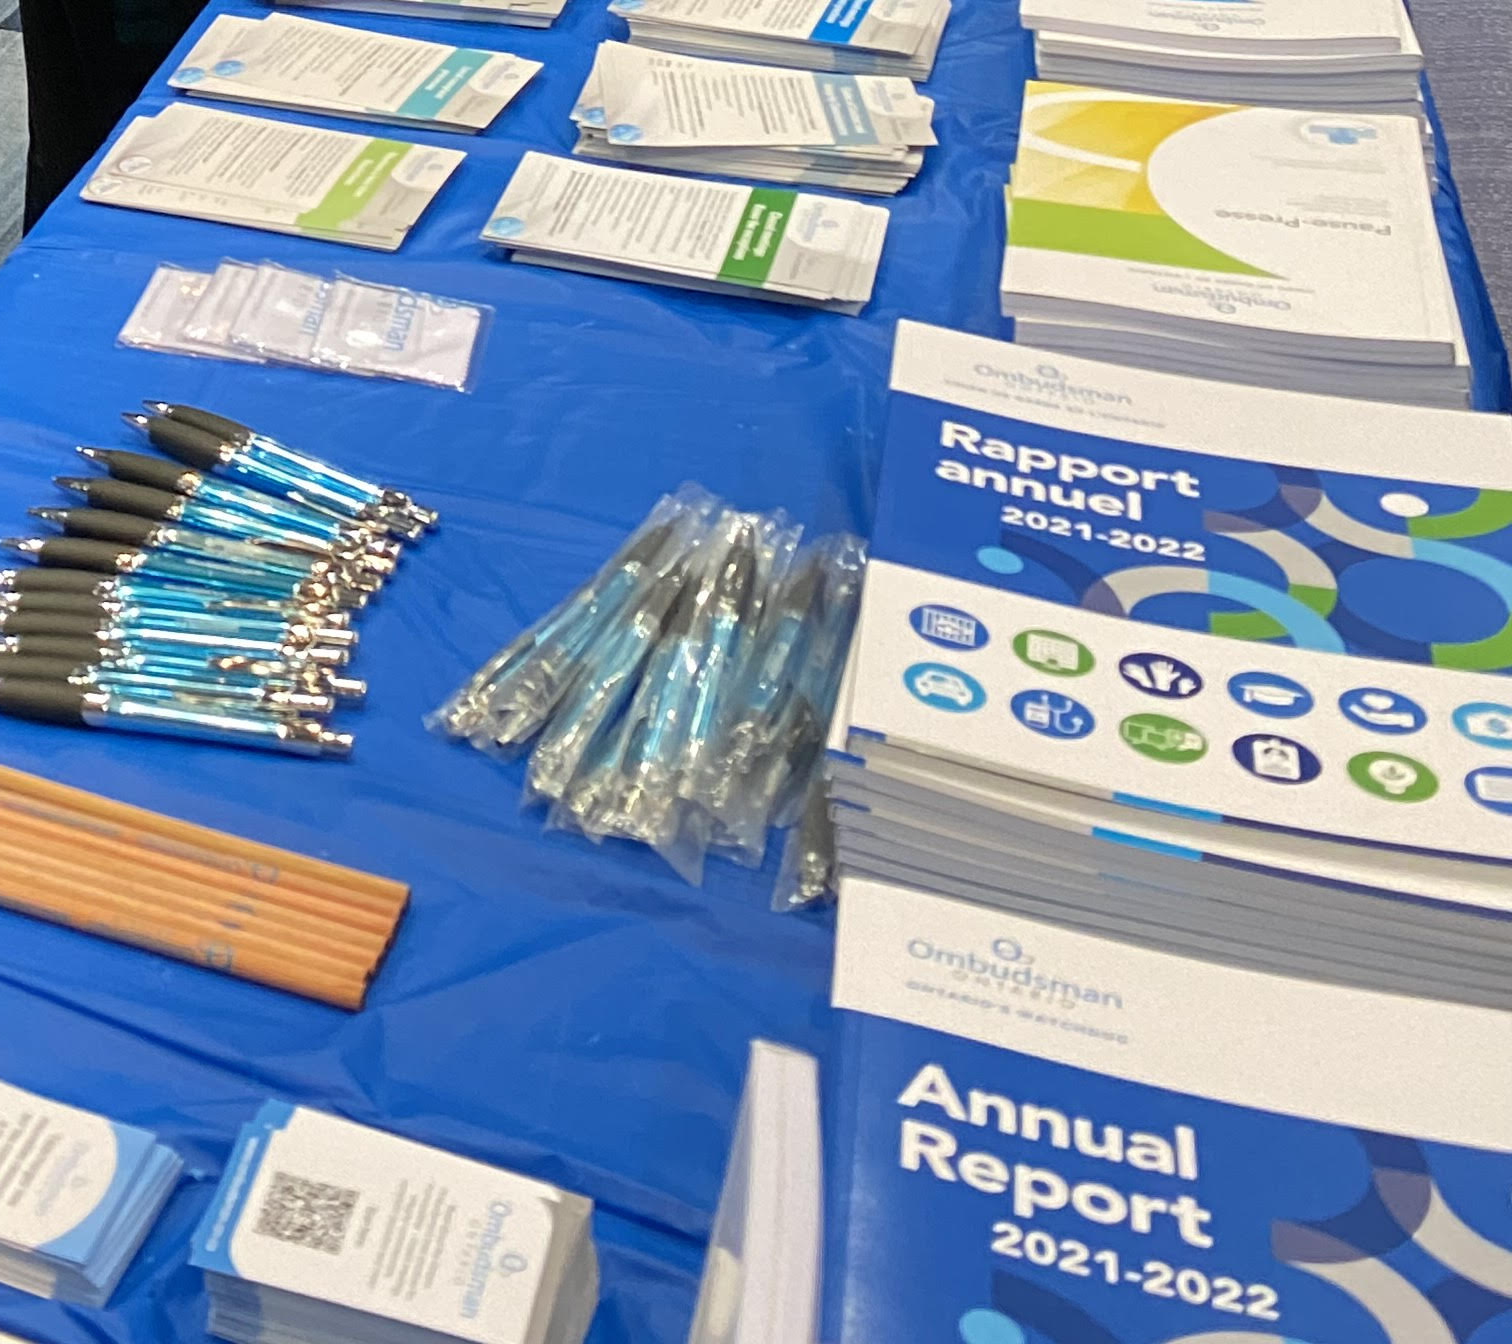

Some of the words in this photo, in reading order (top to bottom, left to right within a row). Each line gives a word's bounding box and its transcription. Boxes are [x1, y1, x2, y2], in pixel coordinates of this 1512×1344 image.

[1215, 210, 1391, 236] Pause-Presse
[935, 454, 1143, 521] annuel
[940, 420, 1201, 499] Rapport
[1001, 506, 1206, 562] 2021-2022
[907, 938, 1124, 1009] Ombudsman
[897, 1062, 1199, 1181] Annual
[899, 1119, 1215, 1249] Report
[991, 1221, 1282, 1321] 2021-2022
